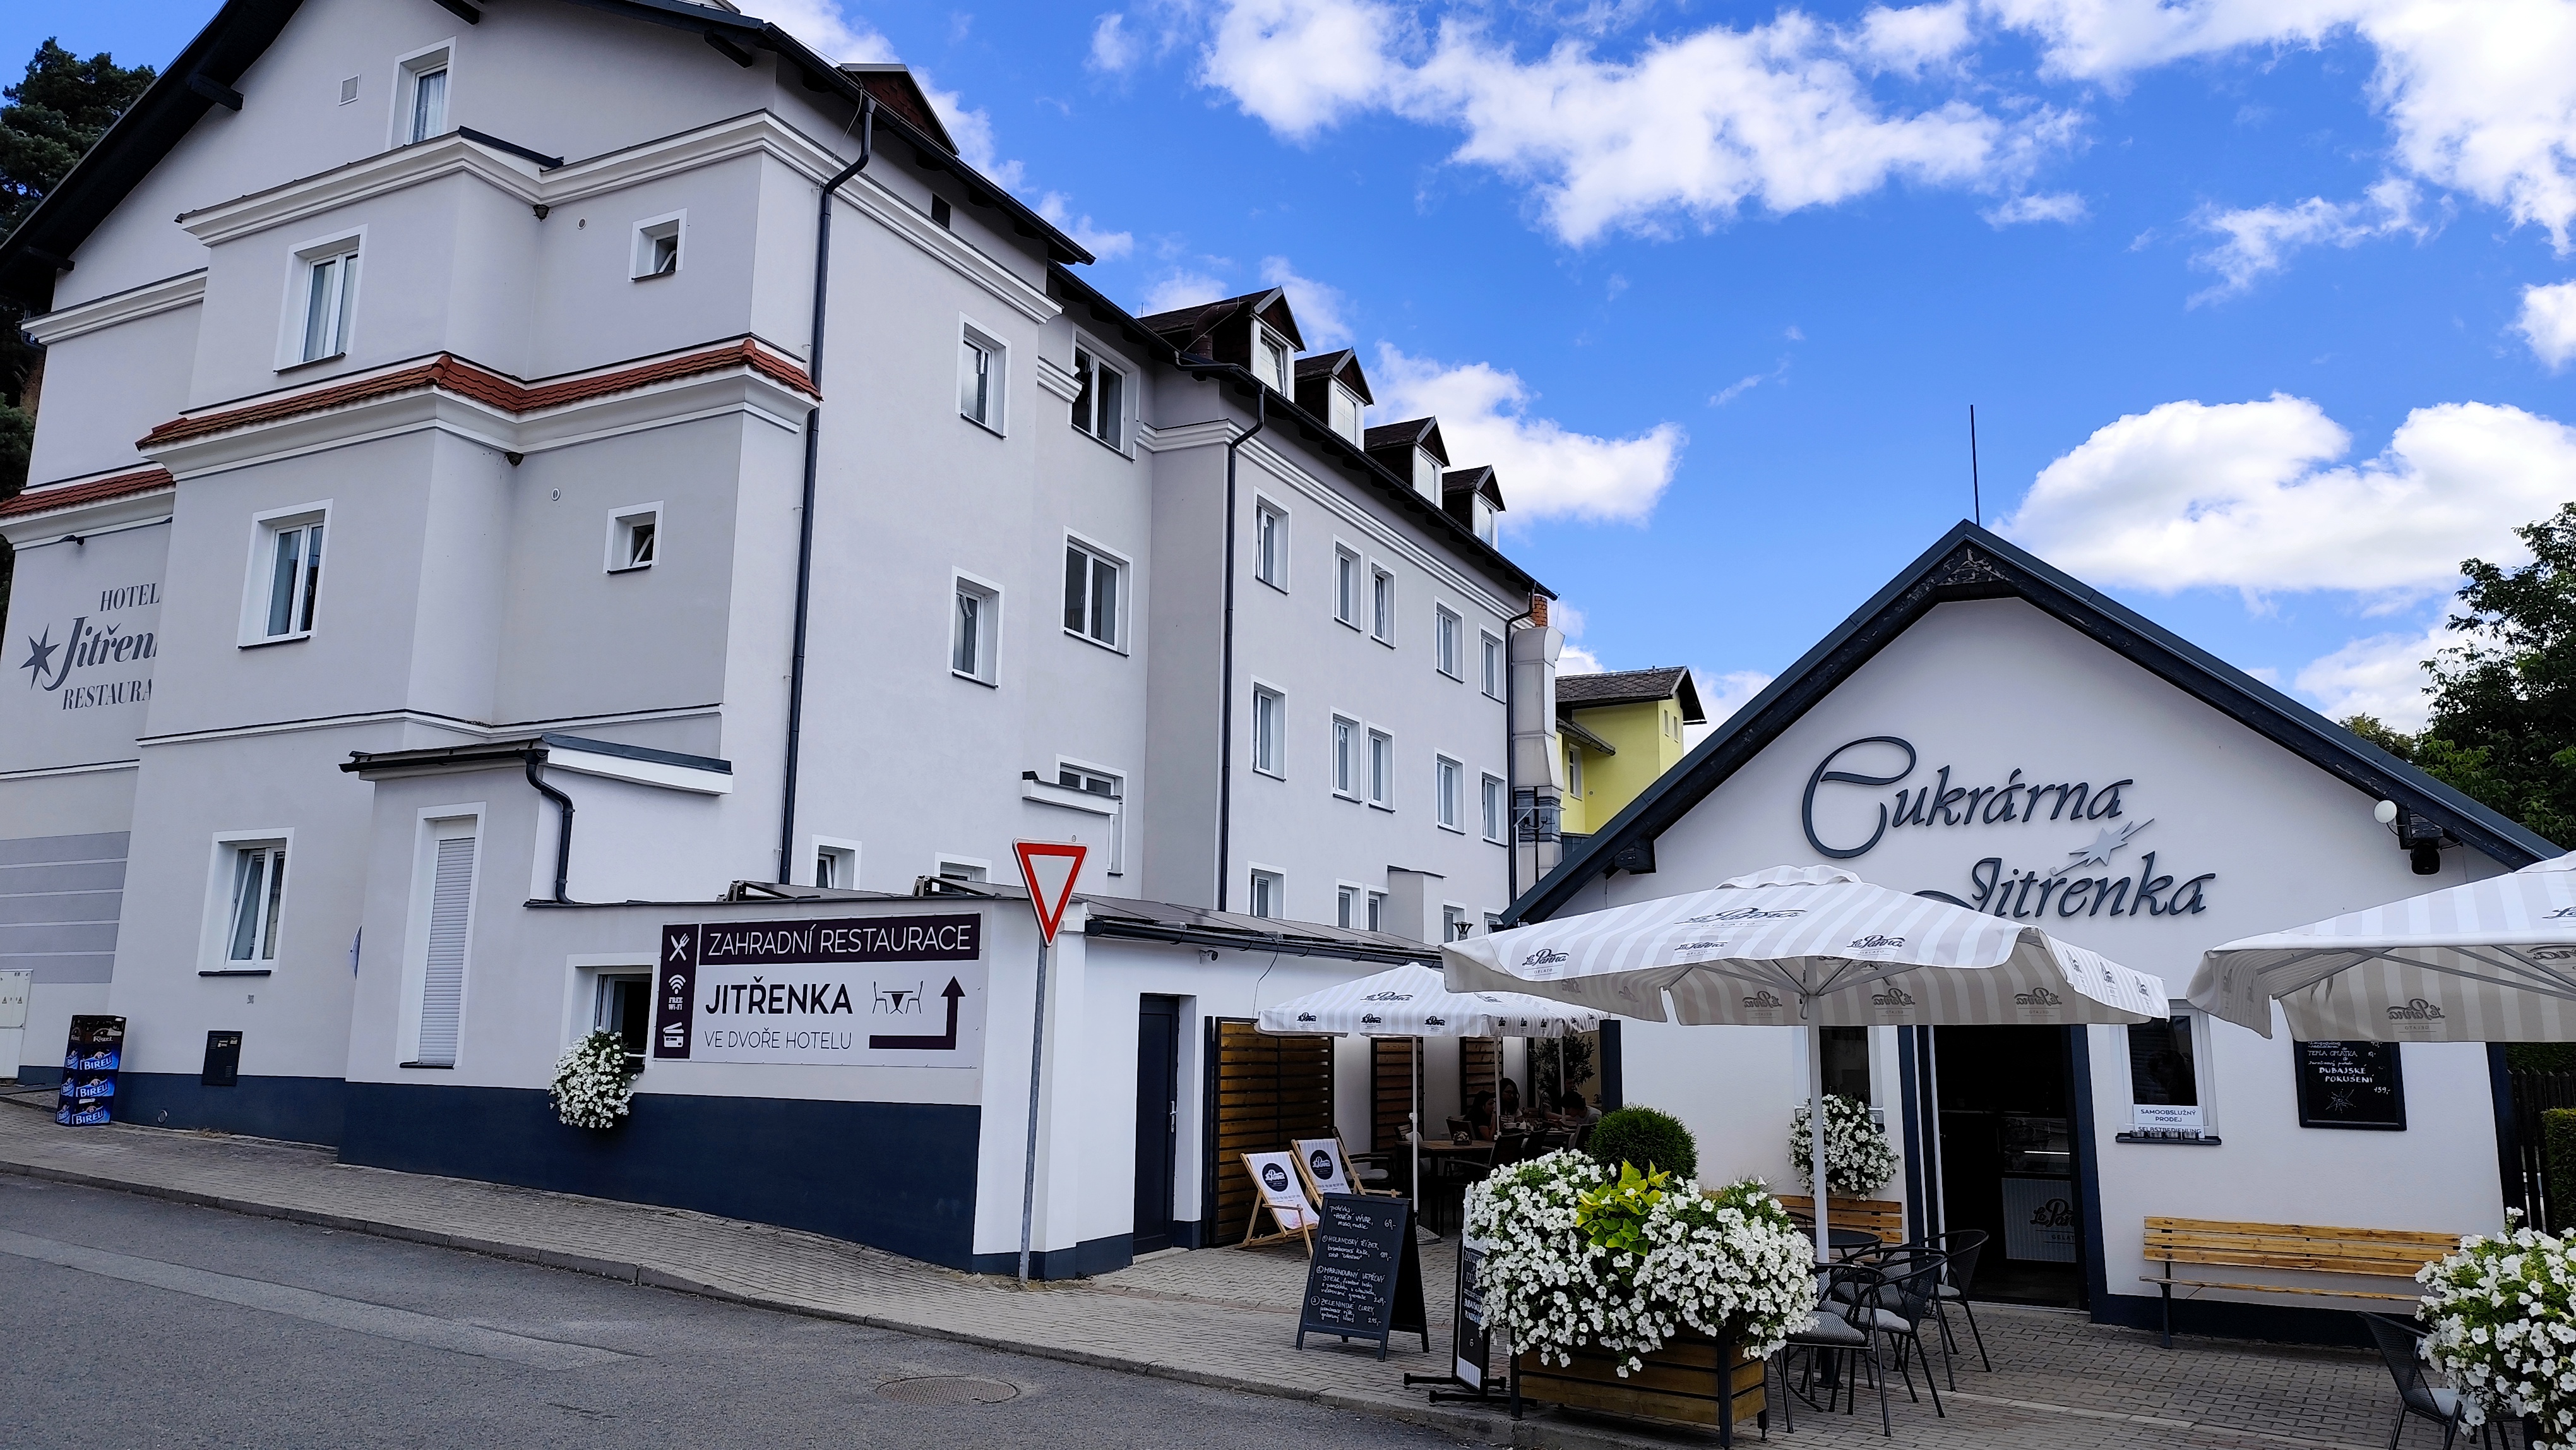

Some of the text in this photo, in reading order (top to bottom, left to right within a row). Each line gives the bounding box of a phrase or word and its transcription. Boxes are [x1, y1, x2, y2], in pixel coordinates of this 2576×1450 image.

[100, 582, 160, 611] HOTEL
[41, 616, 158, 692] Jitřen
[1801, 736, 2133, 858] Cukrárna
[708, 923, 972, 956] ZAHRADNÍ RESTAURACE
[1846, 935, 1905, 949] La Panna
[1522, 949, 1570, 966] La Panna
[705, 976, 854, 1016] JITŘENKA
[704, 1028, 852, 1050] VE DVOŘE HOTELU
[2319, 1064, 2367, 1074] DUBAJSKÉ
[2325, 1074, 2375, 1083] POKUŠENÍ
